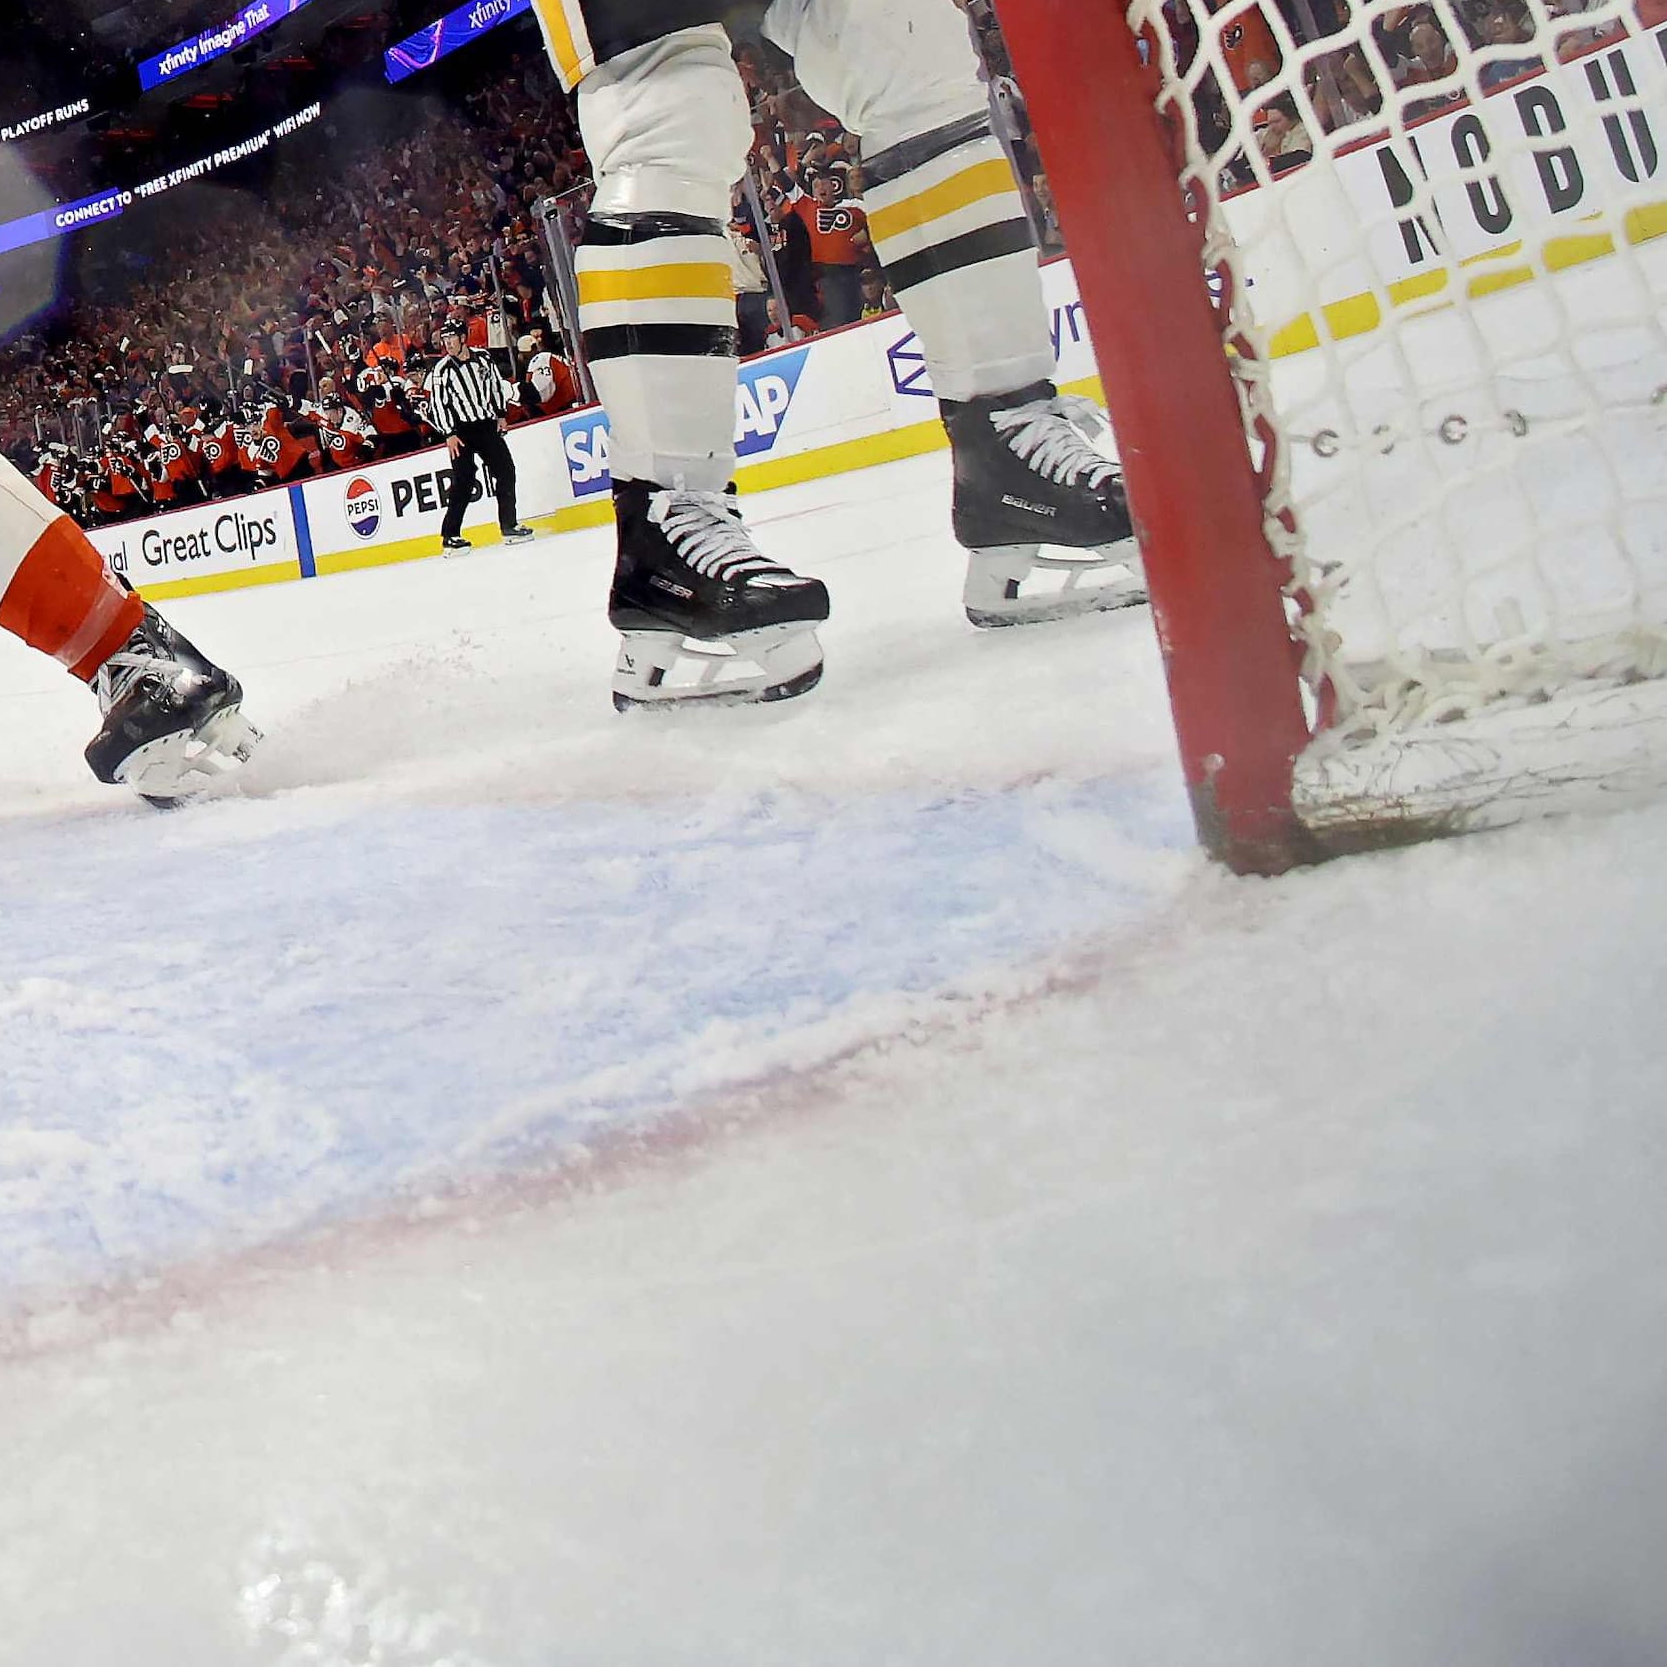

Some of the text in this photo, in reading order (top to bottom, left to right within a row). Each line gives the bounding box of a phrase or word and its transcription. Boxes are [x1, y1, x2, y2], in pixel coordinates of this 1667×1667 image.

[158, 4, 272, 76] xfinity Imagine That
[1, 112, 54, 142] PLAYOFF
[55, 98, 90, 122] RUNS
[1376, 29, 1667, 264] NOBU
[55, 197, 116, 227] CONNECT
[116, 190, 132, 208] TO
[168, 156, 213, 187] XFINITY
[273, 118, 297, 139] WIFI
[296, 102, 321, 128] NOW
[735, 378, 788, 442] AP
[347, 497, 380, 517] PEPSI
[1001, 494, 1058, 518] BAUER
[142, 526, 211, 567] Great
[214, 511, 277, 563] Clips
